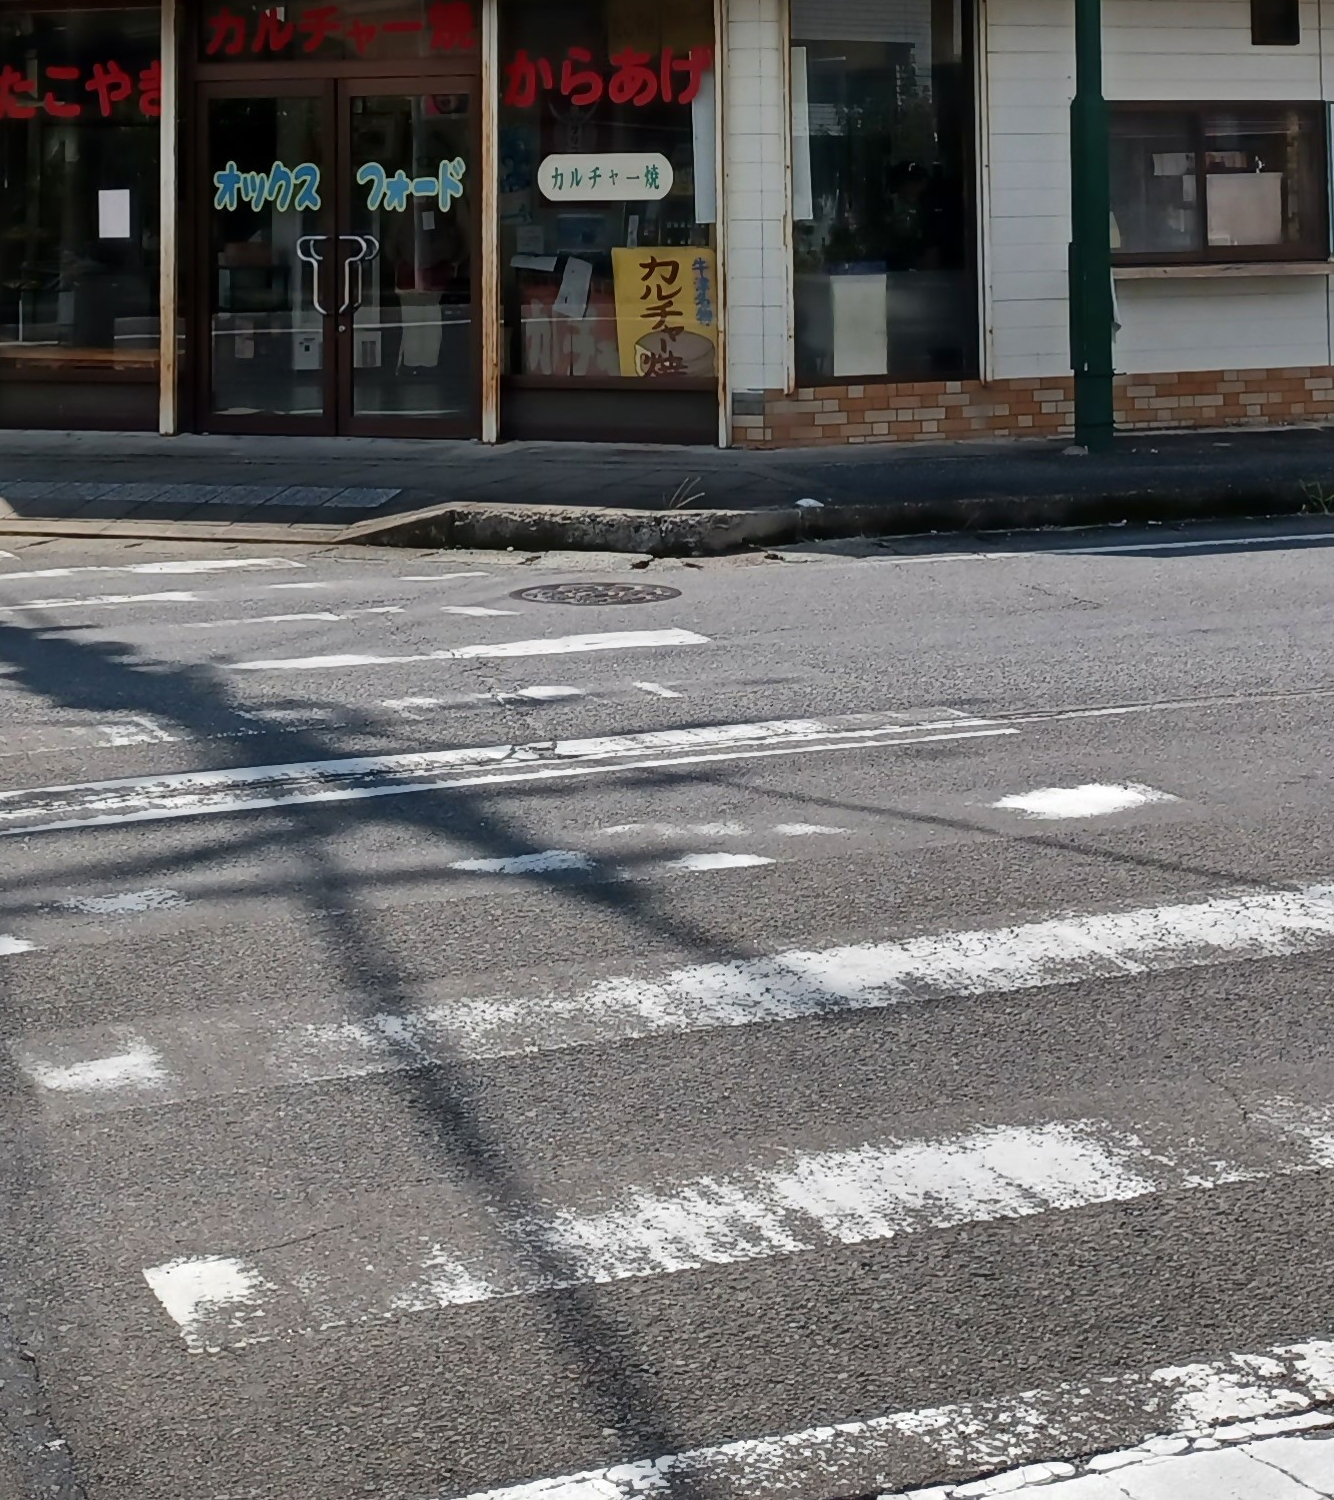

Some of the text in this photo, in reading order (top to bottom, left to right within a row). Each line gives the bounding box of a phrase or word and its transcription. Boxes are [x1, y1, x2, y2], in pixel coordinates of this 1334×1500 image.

[504, 46, 713, 108] からあげ
[214, 160, 321, 212] オックス
[357, 156, 466, 212] フォード
[551, 164, 660, 191] カルチャー焼
